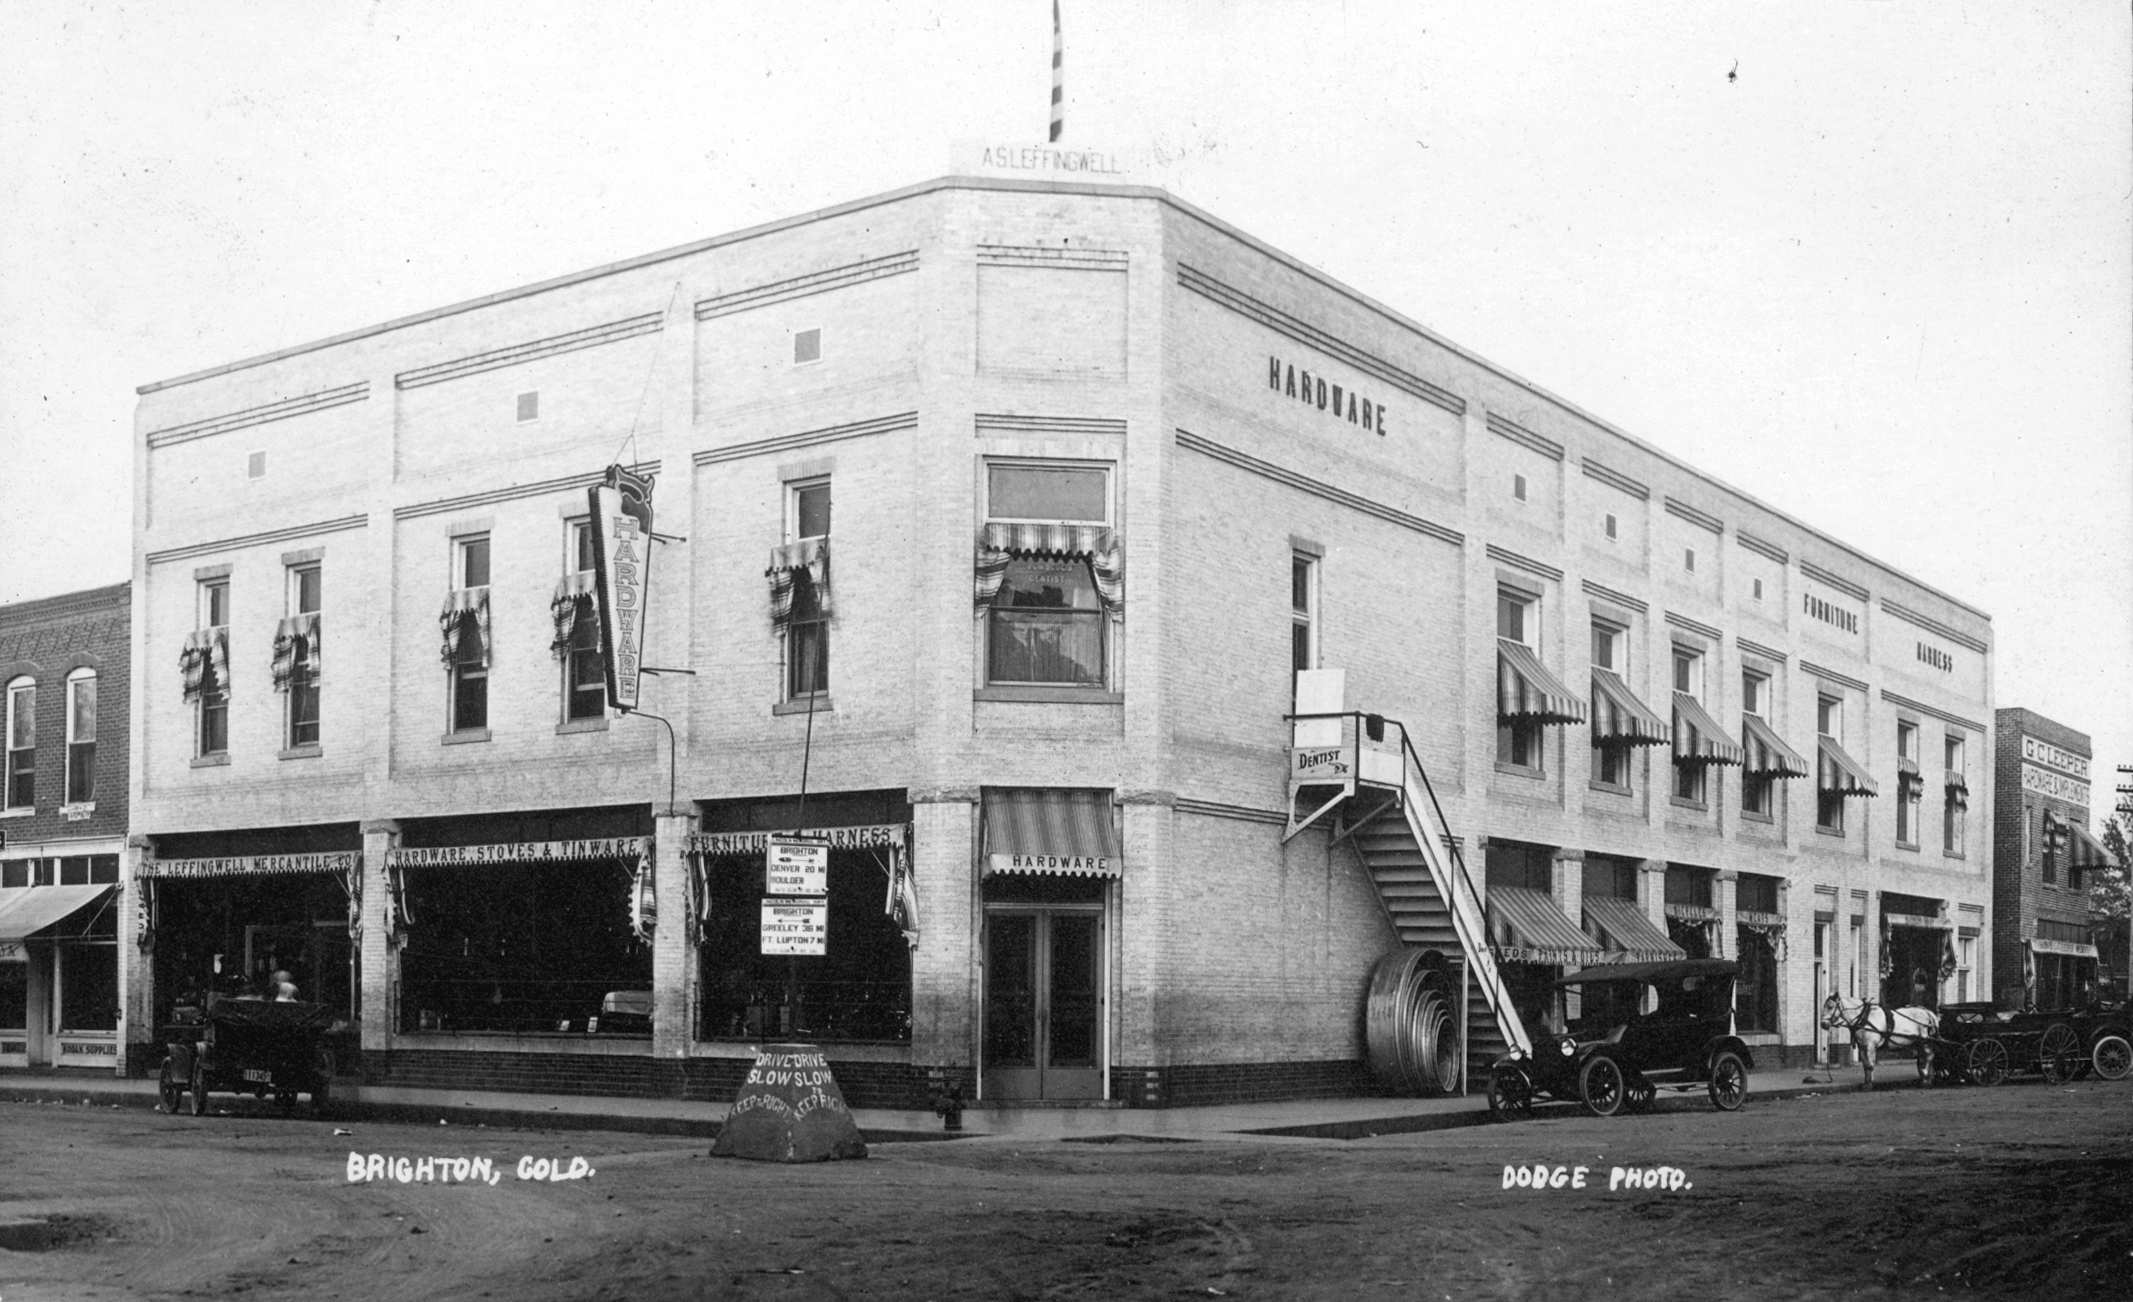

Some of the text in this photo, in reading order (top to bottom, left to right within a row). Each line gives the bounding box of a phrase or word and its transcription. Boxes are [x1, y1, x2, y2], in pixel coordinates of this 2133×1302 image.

[1269, 356, 1386, 436] HARDWARE
[612, 516, 640, 699] HARDWARE
[1804, 593, 1858, 635] FURNITURE
[1917, 641, 1952, 673] HARNESS
[2026, 739, 2088, 776] G C LEEPER
[477, 843, 536, 860] STOVES
[543, 844, 552, 856] &
[561, 838, 638, 857] TINWARE
[691, 834, 768, 851] FURNITUR
[780, 847, 819, 855] BRIGHTON
[141, 863, 161, 875] THE
[168, 858, 246, 875] LEFFINGWELL
[254, 855, 331, 871] MERCANTILE
[771, 865, 800, 873] DENVER
[1013, 856, 1106, 869] HARDWARE
[771, 877, 804, 885] BOULDER
[1490, 948, 1528, 959] SEDS
[85, 1044, 117, 1056] SUPPLIES
[756, 1053, 792, 1067] DRIVE
[793, 1053, 828, 1067] DRIVE
[747, 1069, 793, 1086] SLOW
[794, 1070, 832, 1087] SLOW
[812, 1086, 822, 1095] TO
[763, 1094, 791, 1118] RIGHT
[793, 1094, 819, 1121] KEEP
